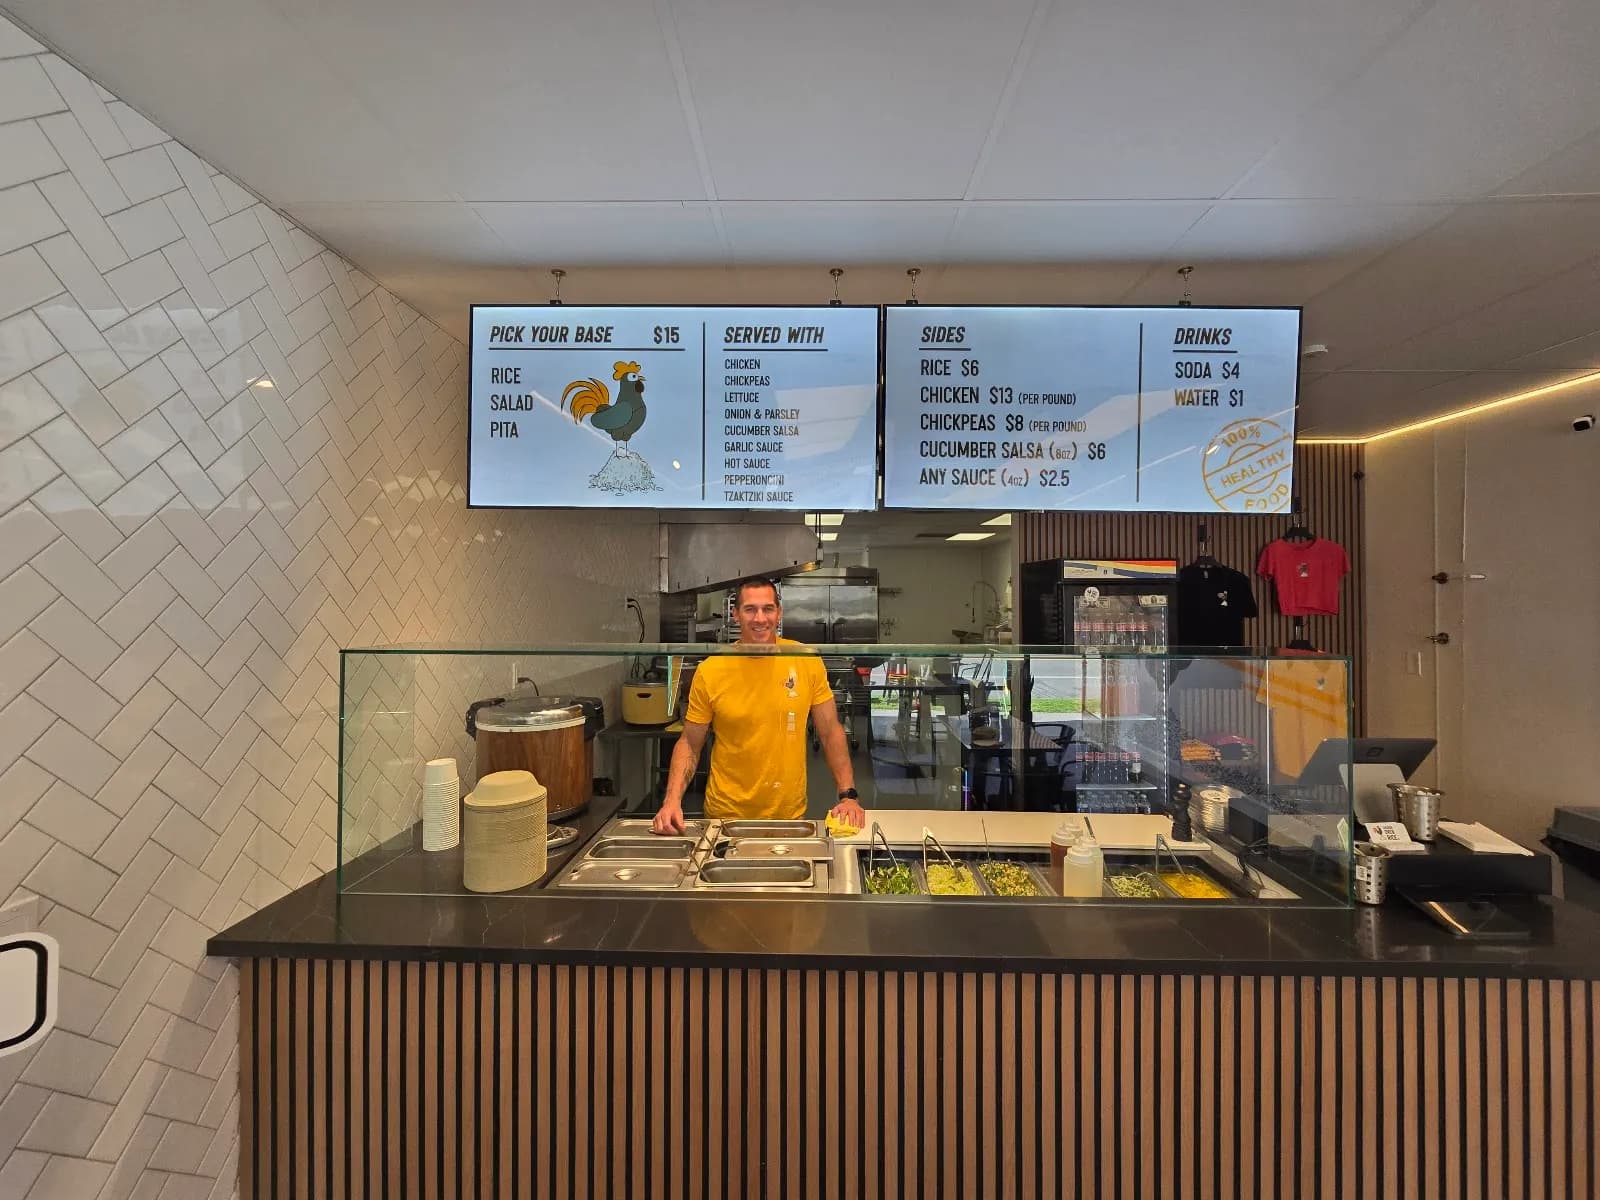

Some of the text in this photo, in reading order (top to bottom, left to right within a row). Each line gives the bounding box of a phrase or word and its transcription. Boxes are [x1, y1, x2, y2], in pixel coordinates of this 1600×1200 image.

[490, 325, 680, 345] PICK YOUR BASE $15
[724, 326, 824, 344] SERVED WITH
[921, 326, 965, 343] SIDES
[1174, 328, 1232, 346] DRINKS
[725, 359, 760, 371] CHICKEN
[921, 359, 979, 378] RICE $6
[1175, 361, 1240, 381] SODA $4
[491, 368, 521, 385] RICE
[725, 375, 770, 388] CHICKPEAS
[490, 395, 533, 412] SALAD
[725, 391, 759, 404] LETTUCE
[920, 386, 1076, 406] CHICKEN $13 (PER POUND)
[1174, 388, 1244, 408] WATER $1
[724, 408, 800, 420] ONION & PARSLEY
[920, 413, 1087, 433] CHICKPEAS $8 (PER POUND)
[490, 421, 519, 439] PITA
[724, 425, 799, 437] CUCUMBER SALSA
[1221, 425, 1261, 447] 100%
[724, 441, 783, 454] GARLIC SAUCE
[920, 440, 996, 460] CUCUMBER
[1001, 441, 1044, 460] SALSA
[1087, 442, 1106, 461] $6
[724, 458, 771, 470] HOT SAUCE
[1220, 449, 1285, 488] HEALTHY
[920, 468, 947, 486] ANY
[951, 468, 996, 487] SAUCE
[1039, 469, 1071, 488] $2.5
[724, 490, 794, 503] TZAKTZIKI SAUCE
[1244, 484, 1288, 510] FOOD
